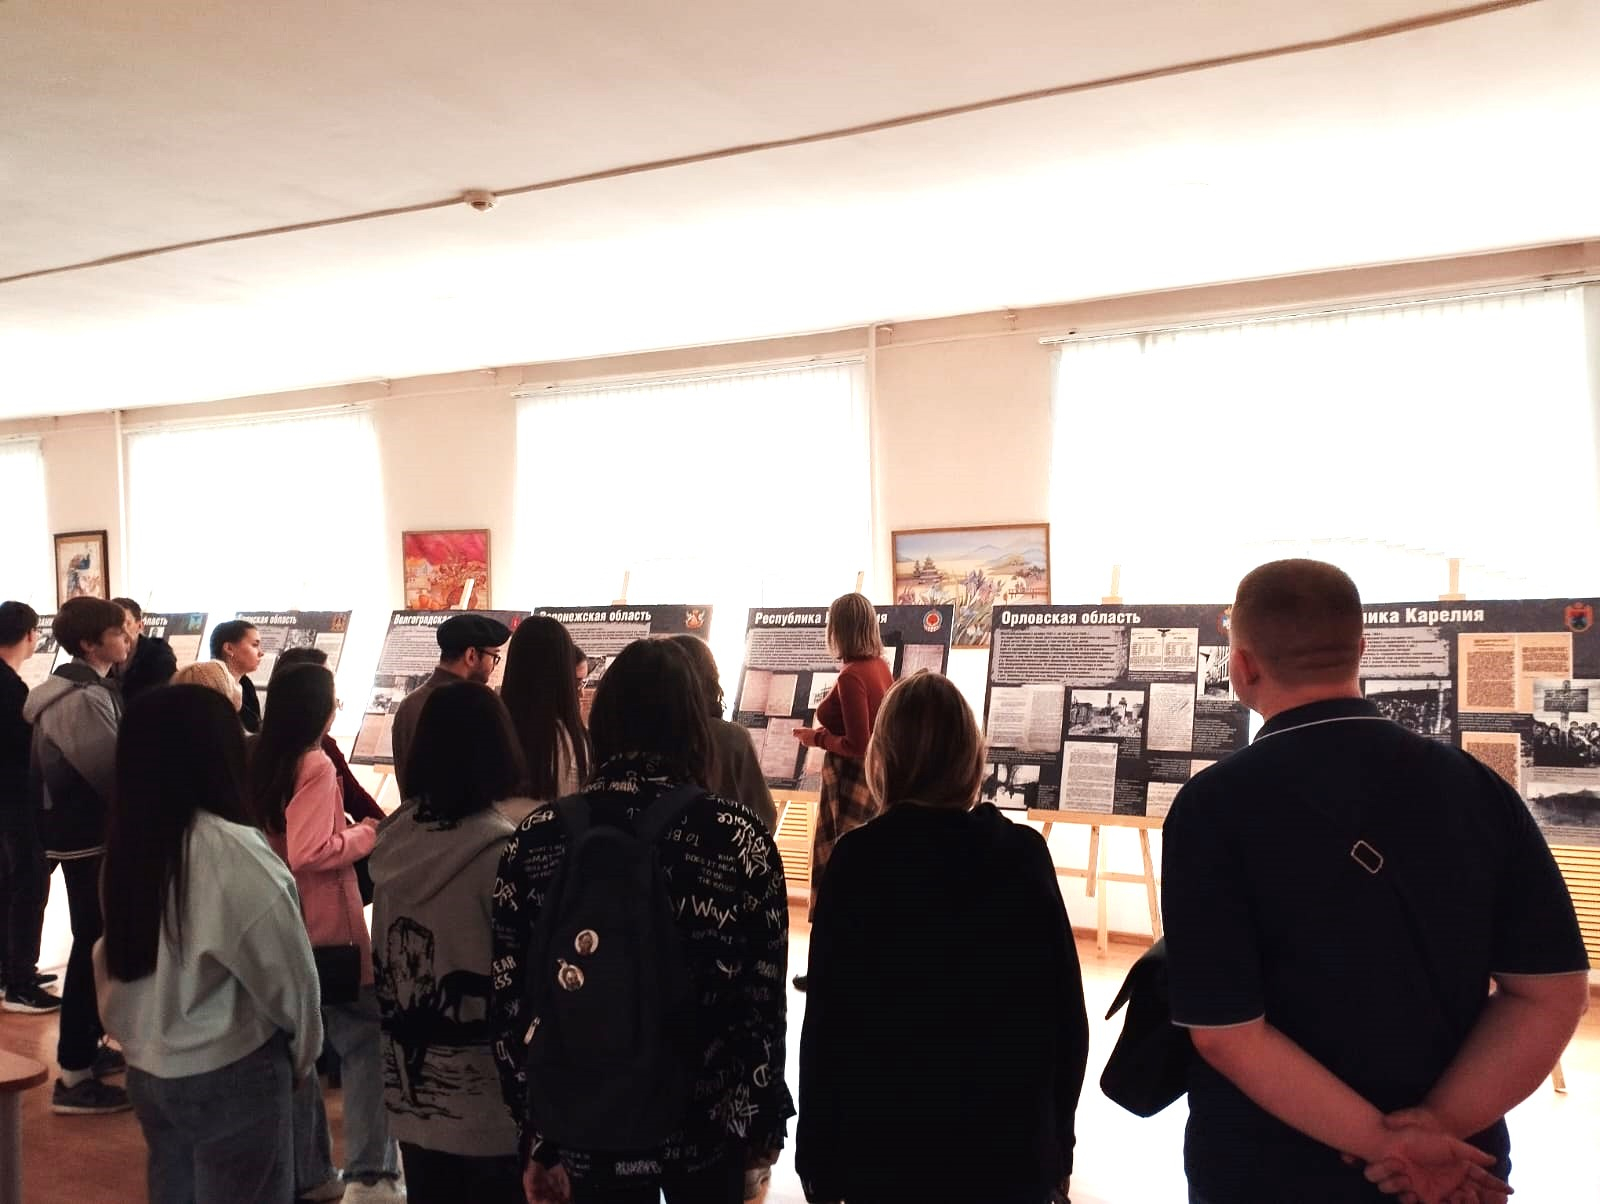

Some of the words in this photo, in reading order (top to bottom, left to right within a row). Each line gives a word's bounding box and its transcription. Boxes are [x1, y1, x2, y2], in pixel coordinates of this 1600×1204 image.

[269, 614, 297, 625] область
[609, 609, 652, 622] область
[754, 611, 822, 627] Республика
[1001, 610, 1077, 626] Орловская
[1081, 610, 1141, 625] область
[1405, 607, 1485, 625] Карелия
